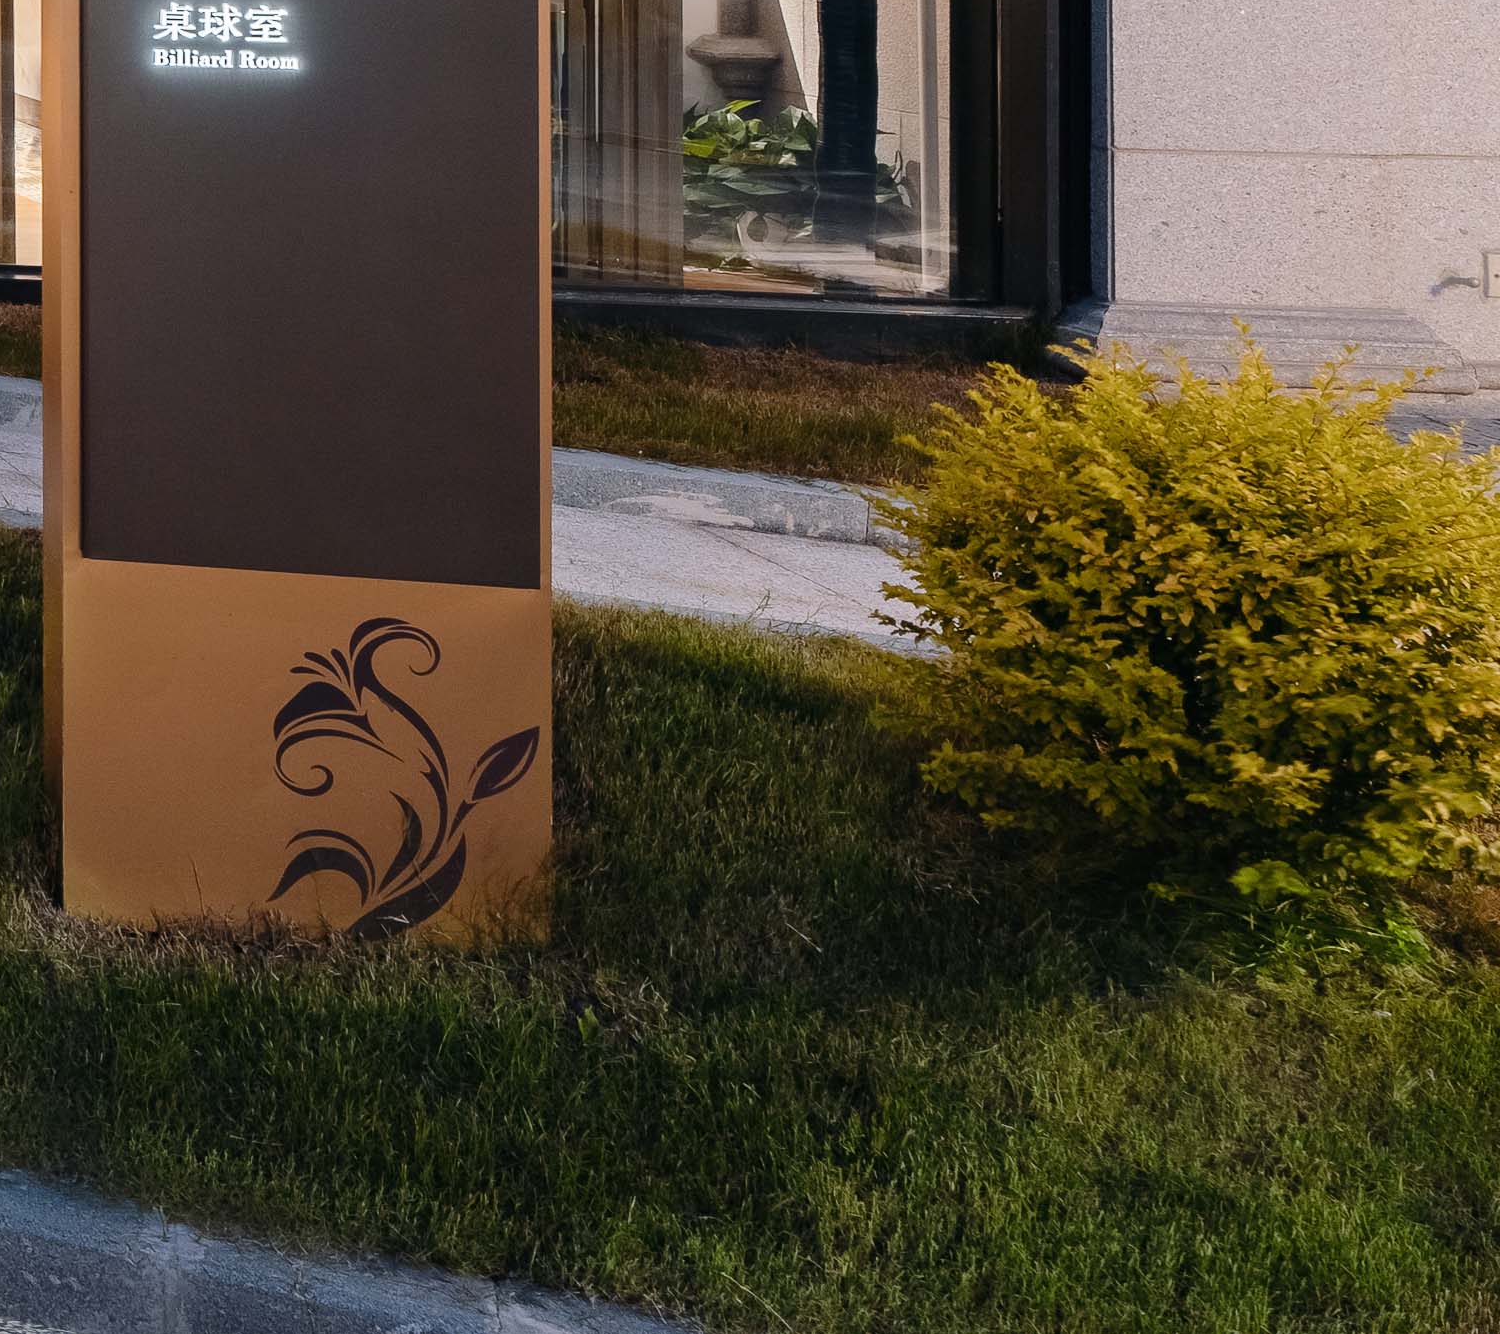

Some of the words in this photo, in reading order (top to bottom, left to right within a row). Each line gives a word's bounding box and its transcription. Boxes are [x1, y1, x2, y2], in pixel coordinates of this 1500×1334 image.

[153, 1, 289, 43] 桌球室
[153, 48, 234, 70] Billiard
[239, 50, 300, 71] Room
